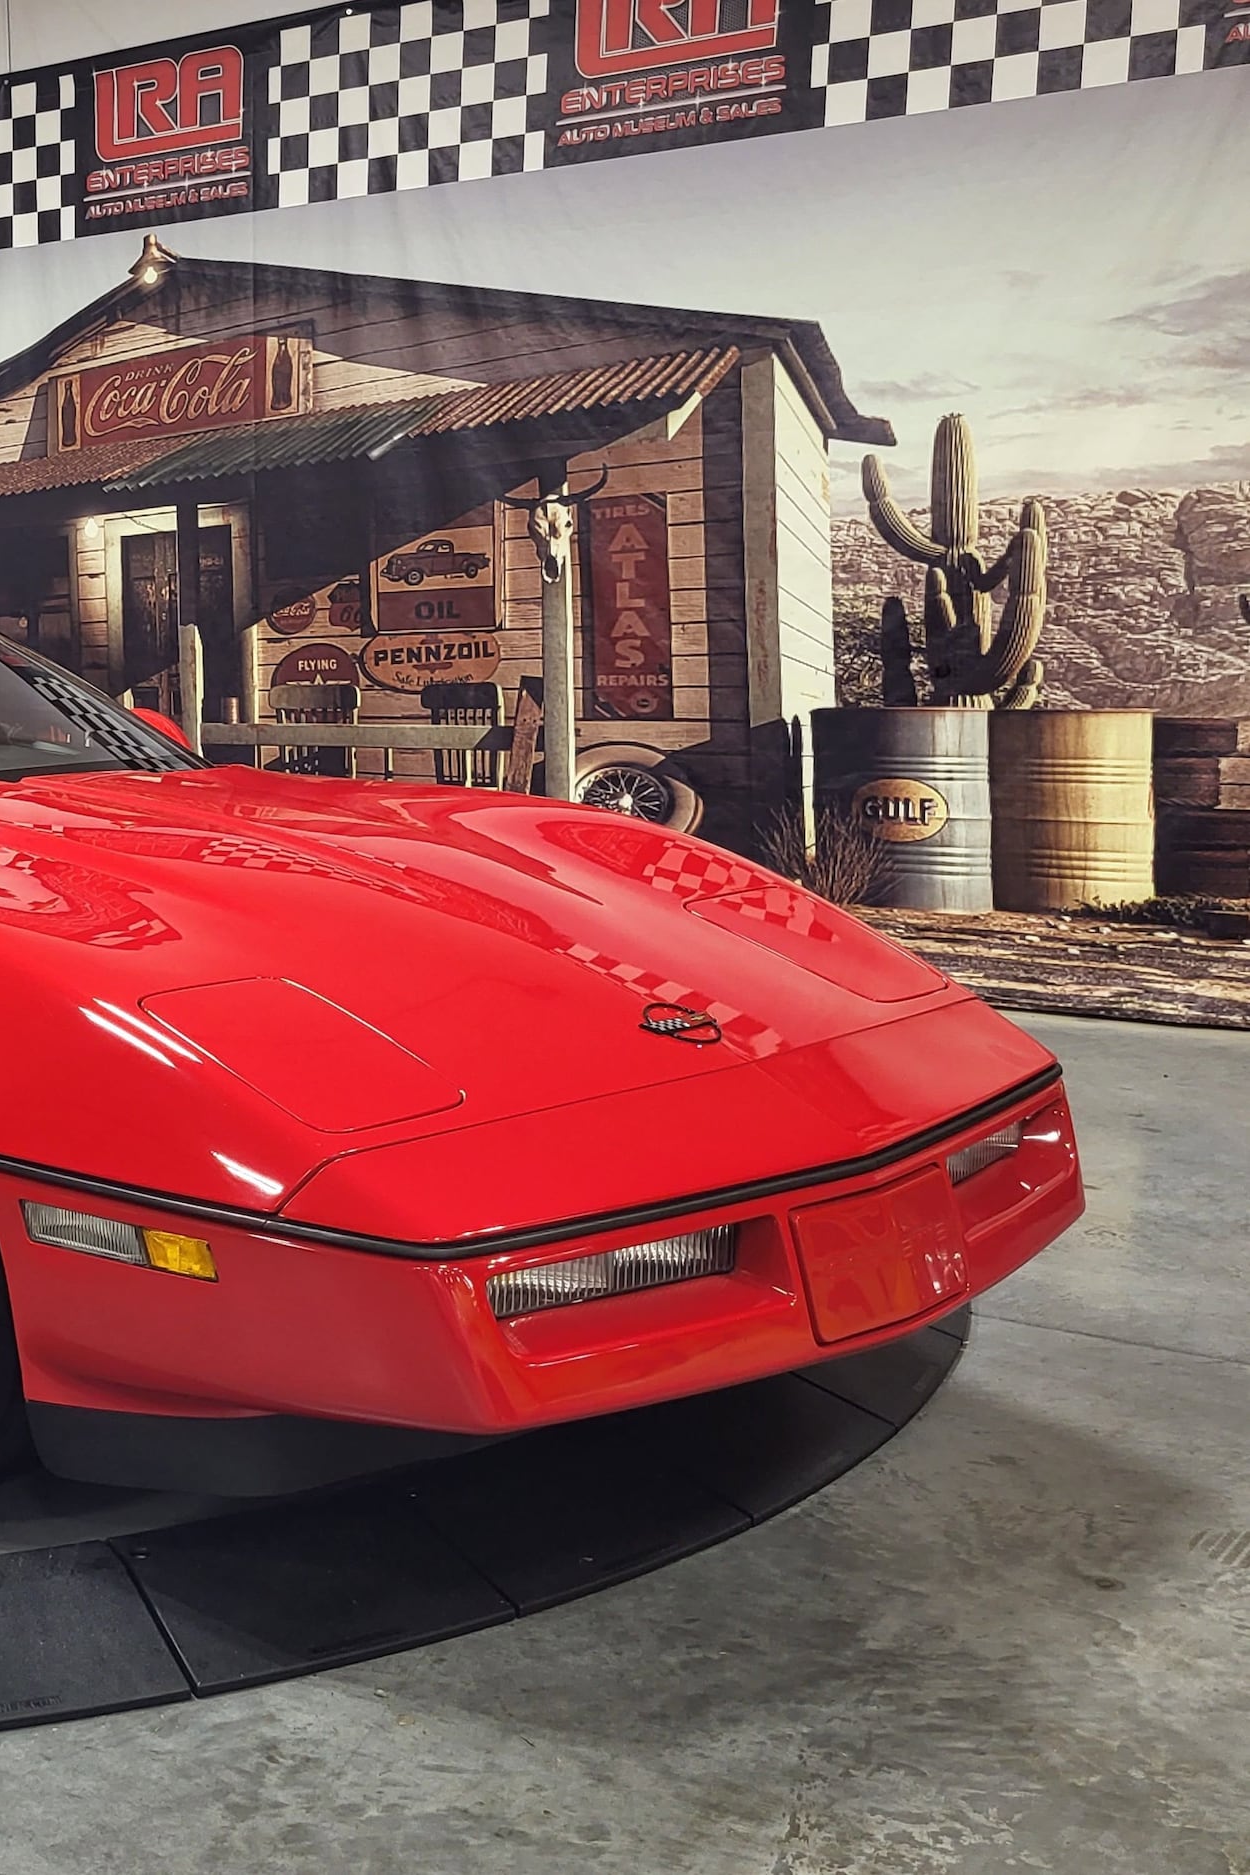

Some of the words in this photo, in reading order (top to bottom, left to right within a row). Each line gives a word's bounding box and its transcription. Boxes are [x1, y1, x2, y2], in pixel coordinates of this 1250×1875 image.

[560, 55, 786, 114] ENTERPRISES
[557, 124, 610, 146] AUTO
[611, 111, 696, 138] MUSEUM
[699, 107, 713, 124] &
[716, 97, 782, 122] SALES
[86, 146, 249, 192] ENTERPRISES
[85, 202, 124, 220] AUTO
[125, 191, 186, 213] MUSEUM
[188, 189, 199, 203] &
[200, 182, 248, 201] SALES
[124, 362, 174, 383] DRINK
[84, 347, 257, 437] Coca-Cola
[591, 504, 650, 519] TIRES
[609, 523, 650, 669] ATLAS
[414, 601, 461, 620] OIL
[298, 659, 337, 671] FLYING
[373, 641, 495, 666] PENNZOIL
[392, 671, 414, 686] Safe
[596, 674, 669, 687] REPAIRS
[863, 795, 938, 826] GULF
